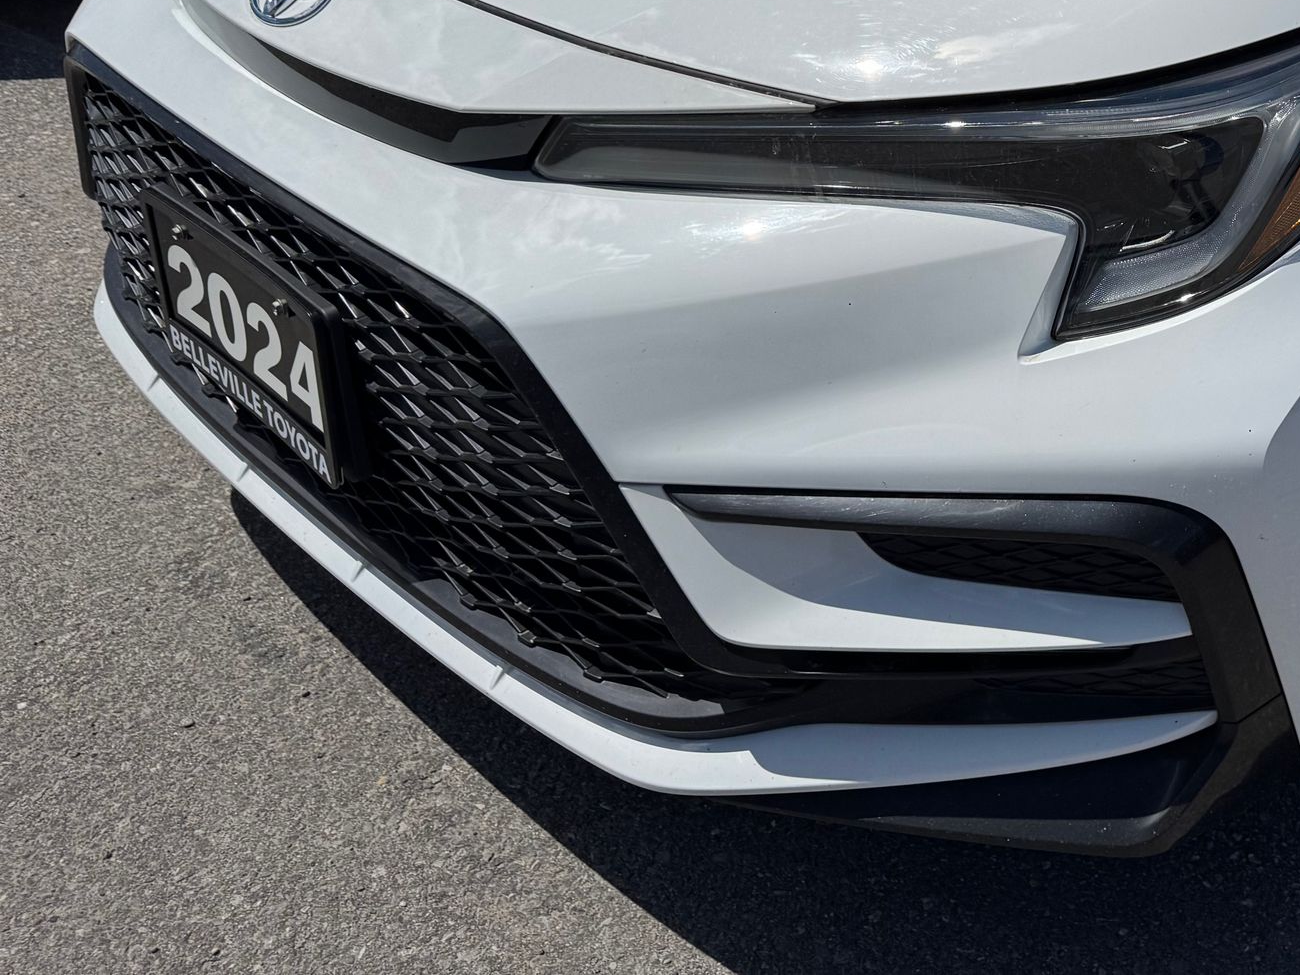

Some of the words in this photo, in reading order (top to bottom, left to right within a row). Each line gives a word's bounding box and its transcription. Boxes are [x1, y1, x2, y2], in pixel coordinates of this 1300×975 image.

[167, 244, 324, 433] 2024
[170, 325, 264, 419] BELLEVILLE
[263, 401, 331, 484] TOYOTA
